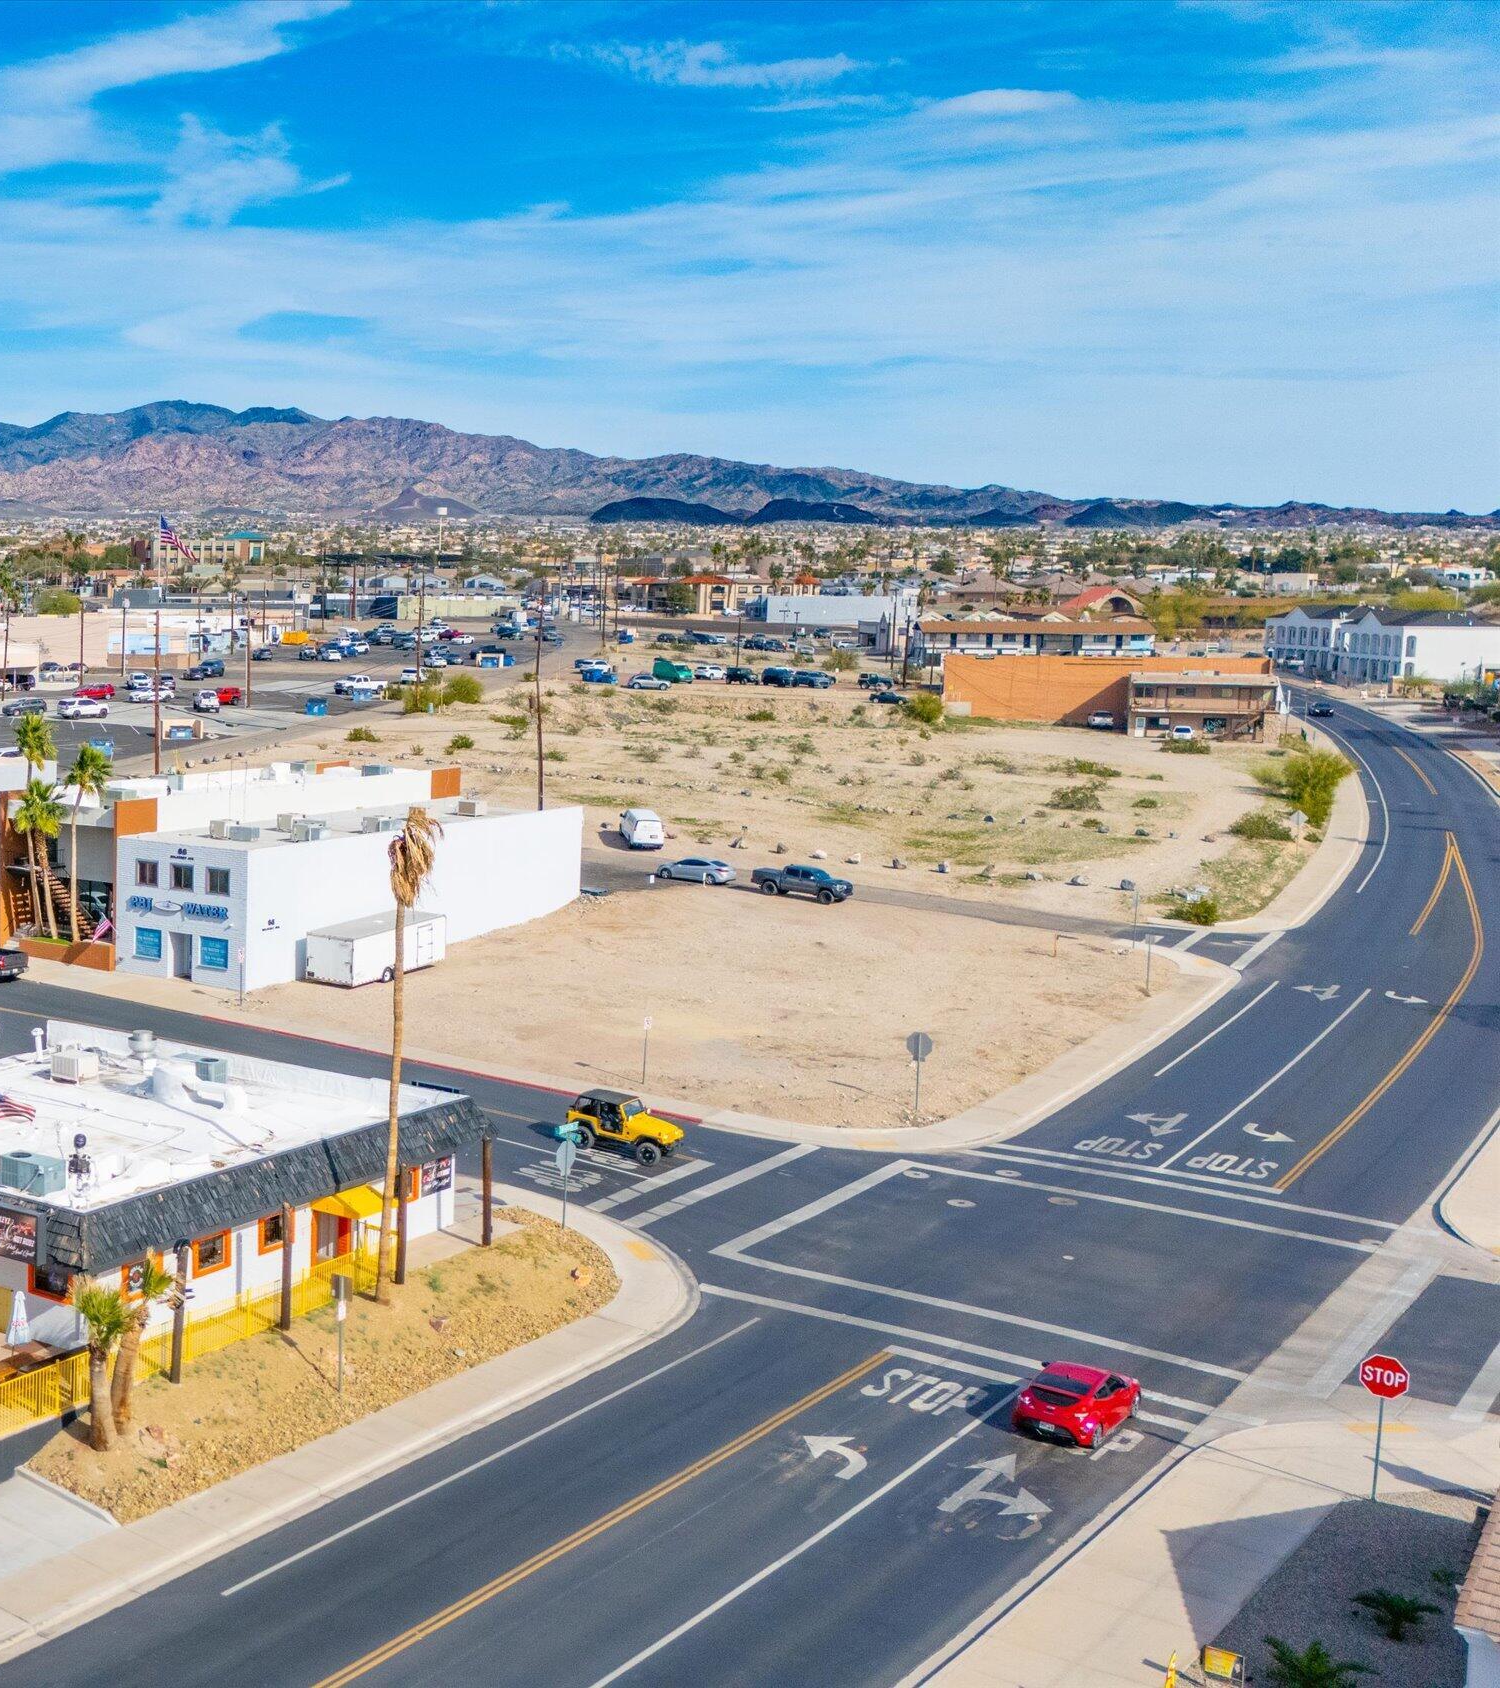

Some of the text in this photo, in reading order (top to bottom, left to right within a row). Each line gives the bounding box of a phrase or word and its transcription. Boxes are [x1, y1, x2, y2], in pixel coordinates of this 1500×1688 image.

[183, 902, 229, 920] WATER
[1073, 1135, 1164, 1159] STOP
[1185, 1152, 1279, 1179] STOP
[1363, 1365, 1406, 1388] STOP
[860, 1368, 988, 1416] STOP
